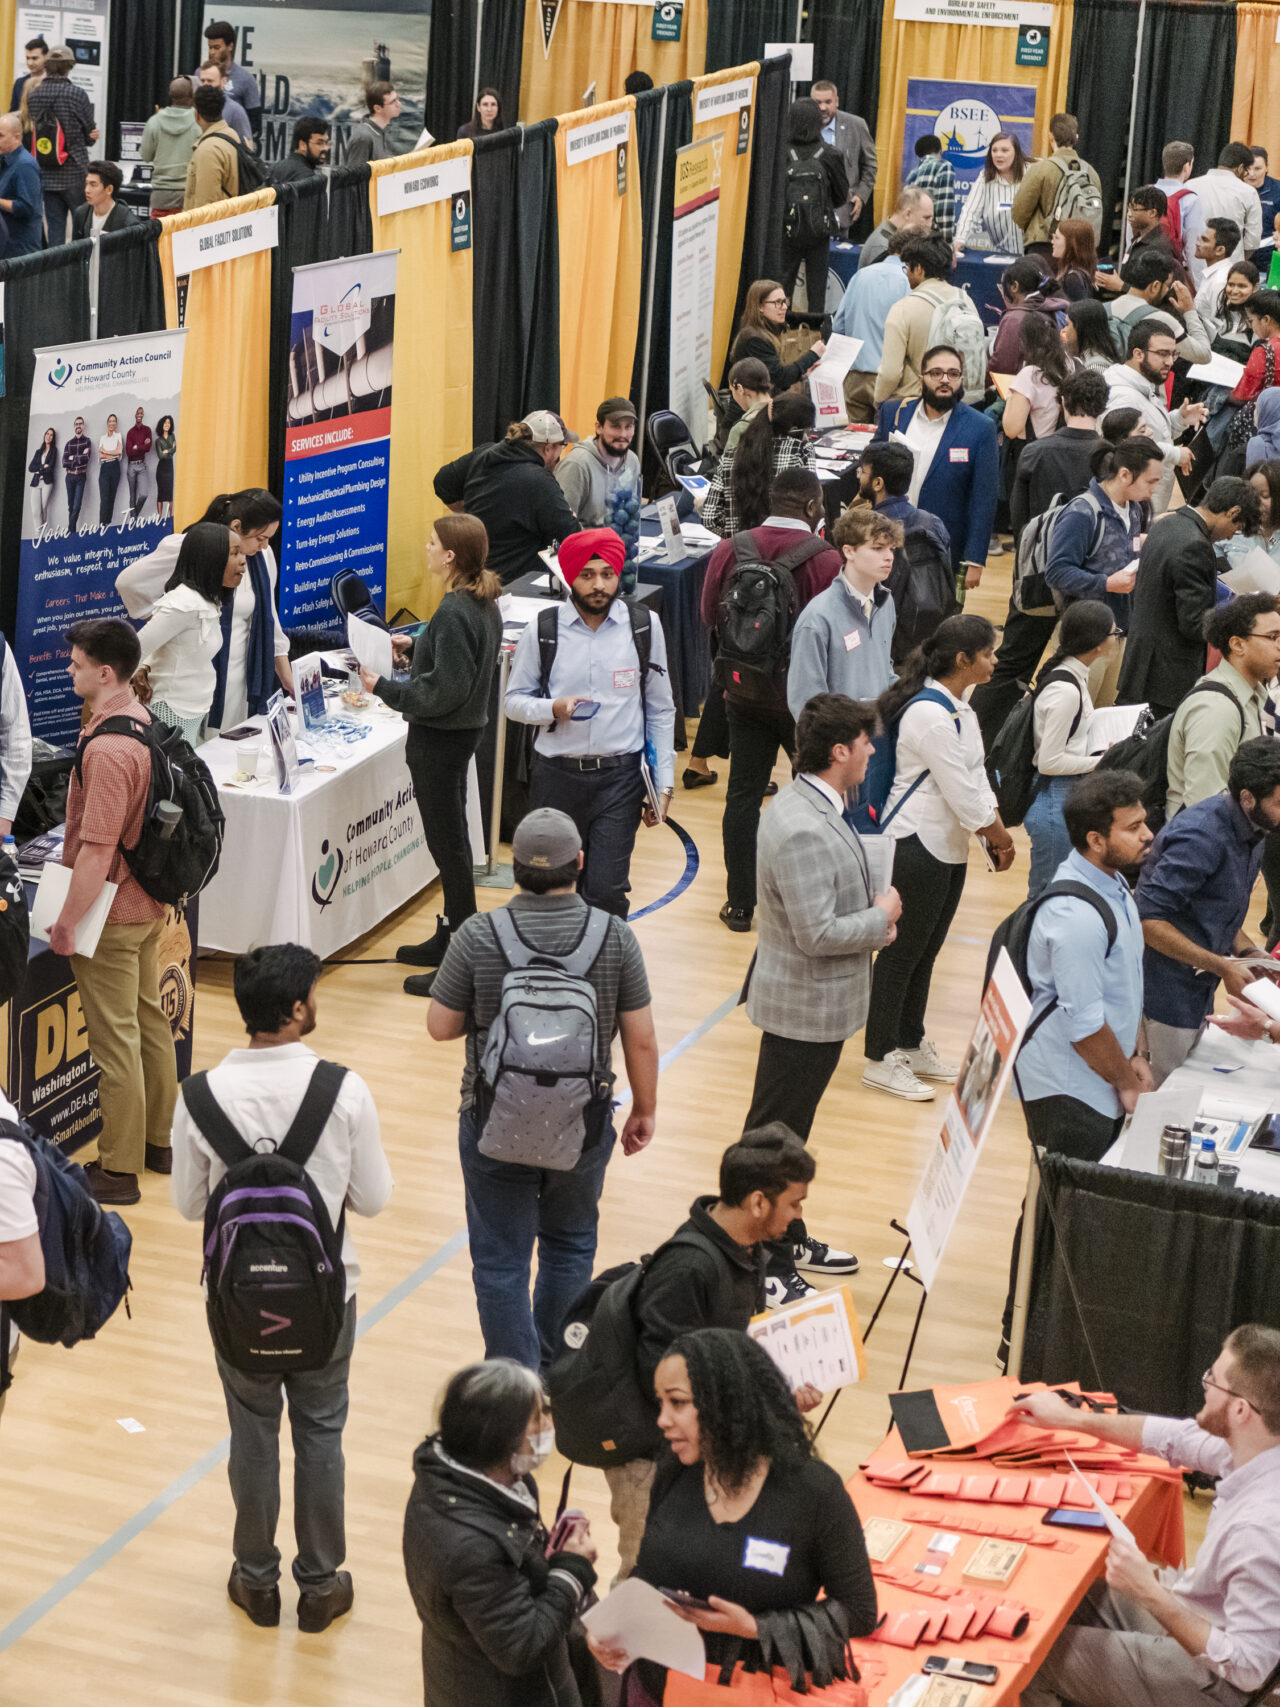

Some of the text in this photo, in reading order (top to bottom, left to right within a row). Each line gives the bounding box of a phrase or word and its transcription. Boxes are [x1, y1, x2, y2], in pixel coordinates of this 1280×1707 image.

[937, 8, 980, 18] ENVIRONMENTAL
[981, 11, 1019, 21] ENFORCEMENT
[977, 1, 996, 10] SAFETY
[950, 106, 989, 122] BSEE
[200, 224, 252, 251] GLOBAL FACILITY SOLUTIONS
[320, 300, 365, 316] GLOBAL
[76, 350, 172, 372] Community Action Council
[75, 369, 136, 385] of Howard County
[291, 427, 354, 453] SERVICES INCLUDE:
[298, 455, 385, 484] Utility Incentive Program Consulting
[370, 477, 386, 489] Design
[296, 503, 365, 528] Energy Audits/Assessments
[31, 506, 170, 549] Join our Team!
[296, 526, 360, 550] Turn-key Energy Solutions
[47, 541, 150, 566] We value integrity, teamwork,
[295, 549, 344, 572] Retro-Commissioning
[348, 541, 385, 559] Commissioning
[33, 558, 119, 582] enthusiasm, respect, and
[294, 579, 317, 594] Building
[45, 595, 70, 609] Careers
[74, 592, 88, 604] That
[89, 590, 107, 602] Make
[293, 597, 329, 615] Arc Flash Safety
[36, 615, 51, 625] When
[64, 612, 75, 621] join
[75, 610, 85, 618] our
[85, 607, 100, 616] team,
[101, 606, 112, 614] you
[113, 604, 125, 613] gain
[328, 615, 339, 627] and
[33, 627, 46, 637] great
[46, 624, 57, 633] job,
[58, 623, 70, 632] you
[29, 650, 52, 664] Benefits
[346, 799, 394, 843] Community
[343, 816, 414, 874] of Howard County
[342, 874, 371, 898] HELPING
[394, 838, 420, 864] CHANGING
[35, 989, 90, 1081] DE
[31, 1060, 87, 1105] Washington
[50, 1088, 98, 1127] www.DEA.go
[250, 1264, 288, 1272] accenture
